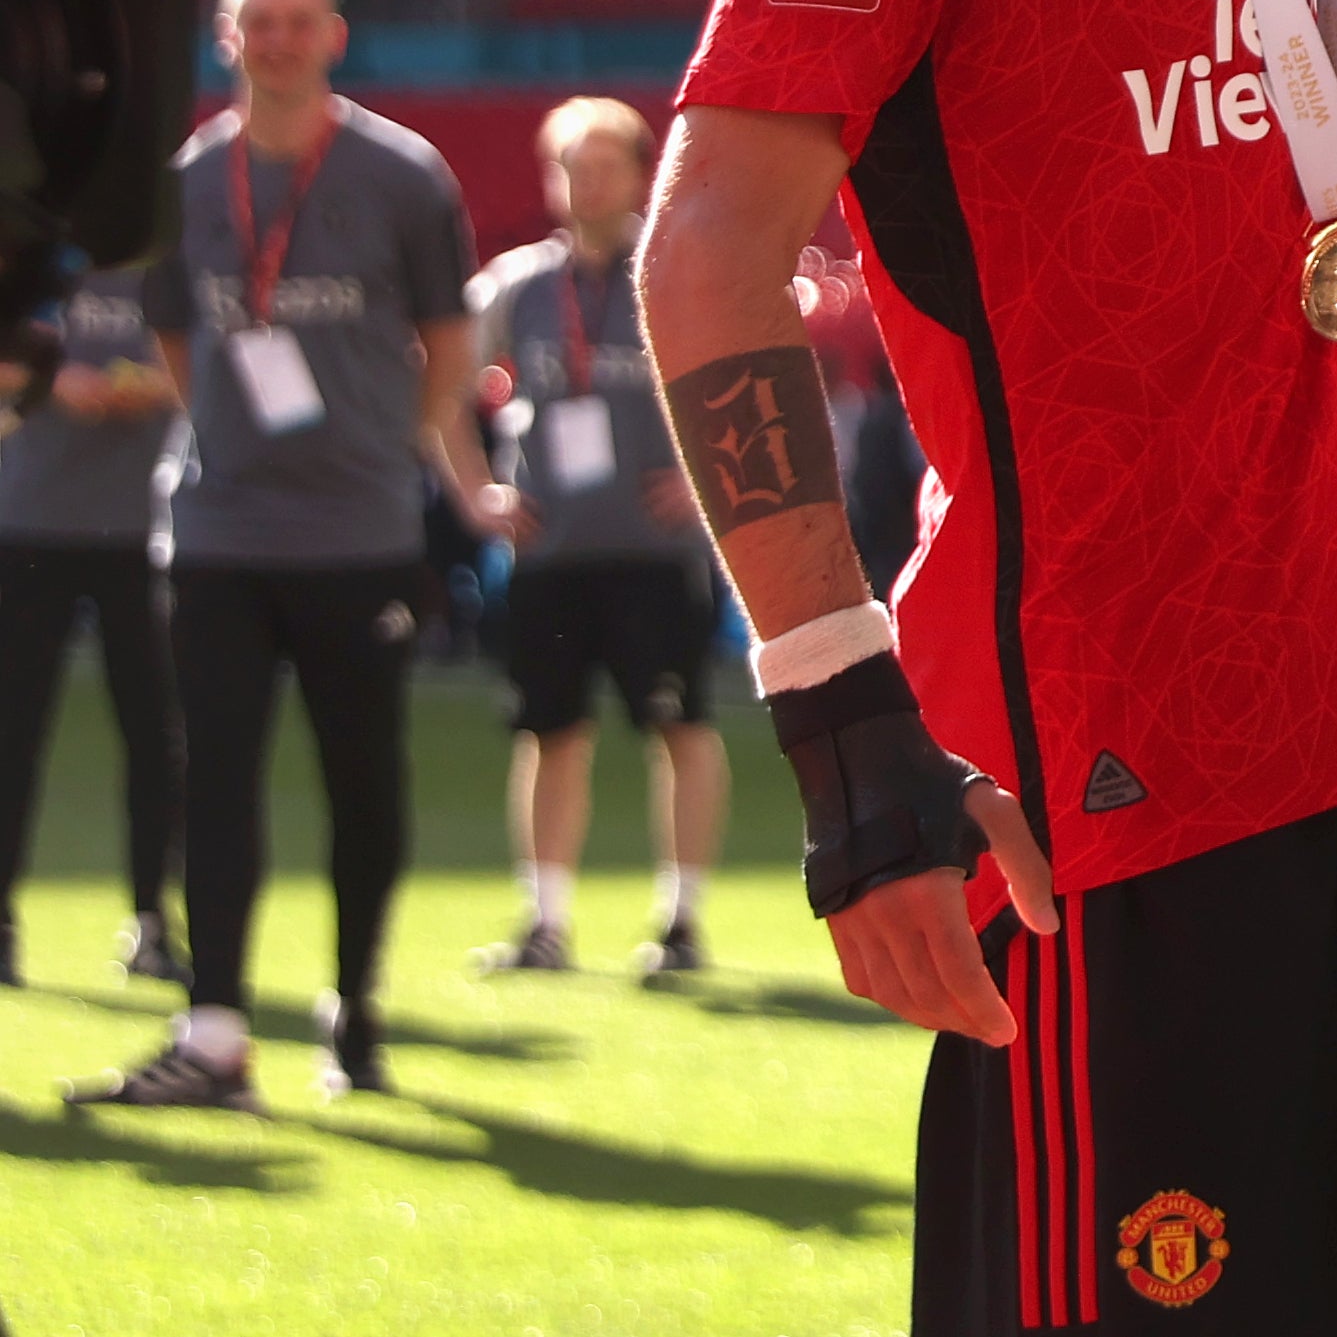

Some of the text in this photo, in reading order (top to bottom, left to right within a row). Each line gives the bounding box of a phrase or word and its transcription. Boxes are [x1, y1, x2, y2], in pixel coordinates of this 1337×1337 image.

[1278, 53, 1310, 121] 2023-24
[1288, 34, 1331, 129] WINNER
[1128, 1199, 1217, 1238] MANCHESTER
[1148, 1276, 1208, 1299] UNITED
